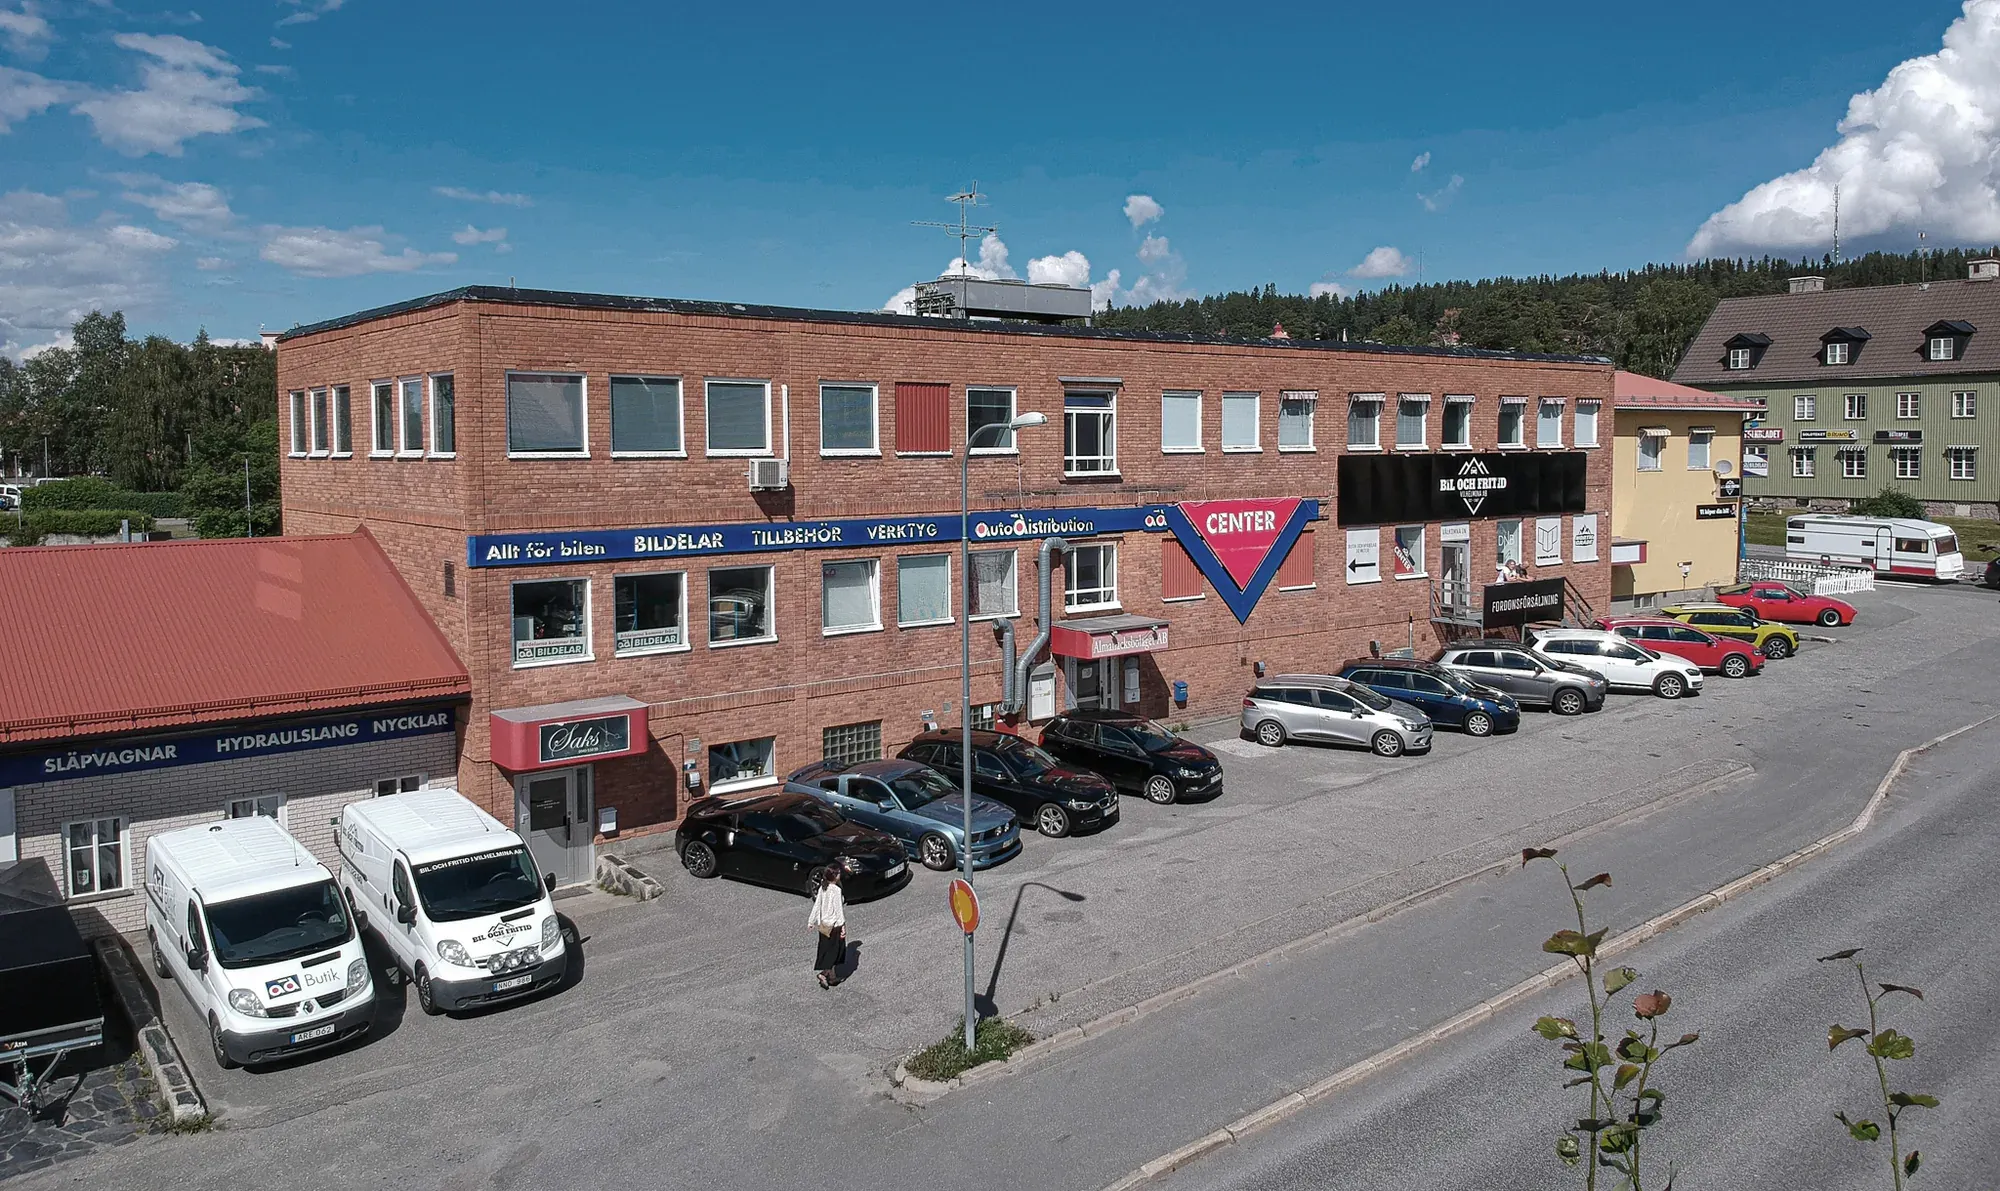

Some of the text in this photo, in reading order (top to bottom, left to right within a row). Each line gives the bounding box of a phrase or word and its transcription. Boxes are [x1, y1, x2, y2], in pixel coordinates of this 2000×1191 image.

[1457, 478, 1476, 490] OCH
[1205, 510, 1276, 534] CENTER
[486, 523, 939, 560] Allt för bilen BILDELAR TILLBEHÖR VERKTYG
[1491, 593, 1559, 613] FORDONSFÖRSÄLJNING
[634, 635, 676, 647] BILDELAR
[1157, 631, 1168, 645] AB
[537, 645, 581, 656] BILDELAR
[216, 713, 449, 753] HYDRAULSLANG NYCKLAR
[548, 724, 600, 757] Saks
[44, 745, 178, 773] SLÄPVAGNAR
[419, 866, 432, 874] BIL
[432, 863, 448, 871] OCH
[448, 857, 470, 867] FRITID
[474, 850, 514, 861] VILHELMINA
[472, 935, 487, 943] BIL
[488, 929, 505, 938] OCH
[506, 924, 532, 934] FRITID
[304, 968, 340, 987] Butik
[298, 1026, 332, 1040] ARE 062
